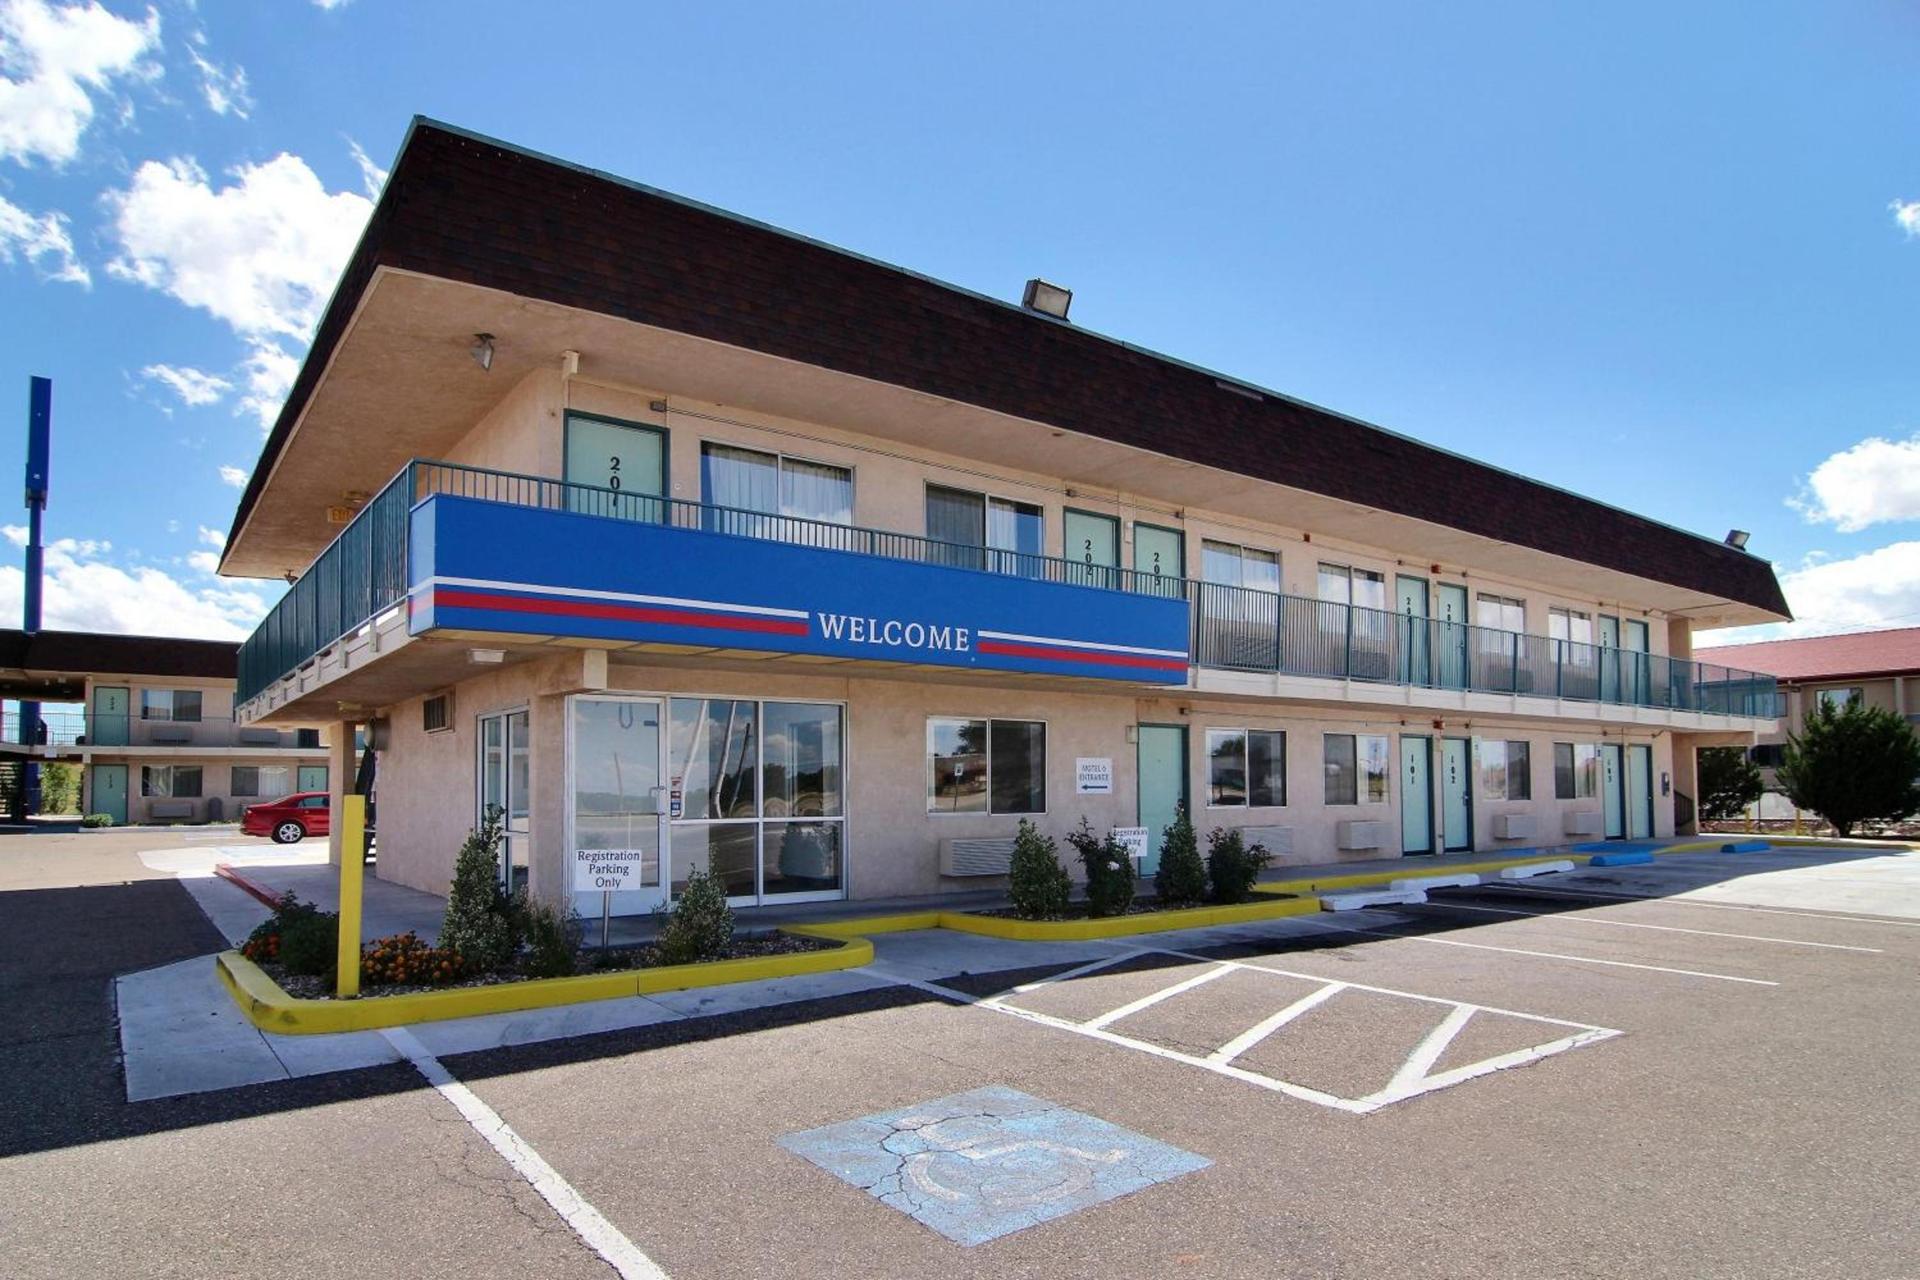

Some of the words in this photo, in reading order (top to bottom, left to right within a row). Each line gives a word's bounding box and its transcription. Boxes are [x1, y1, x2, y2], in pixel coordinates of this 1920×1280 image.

[817, 612, 970, 652] WELCOME
[577, 850, 640, 863] Registration
[589, 863, 630, 877] Parking
[595, 876, 622, 889] Only
